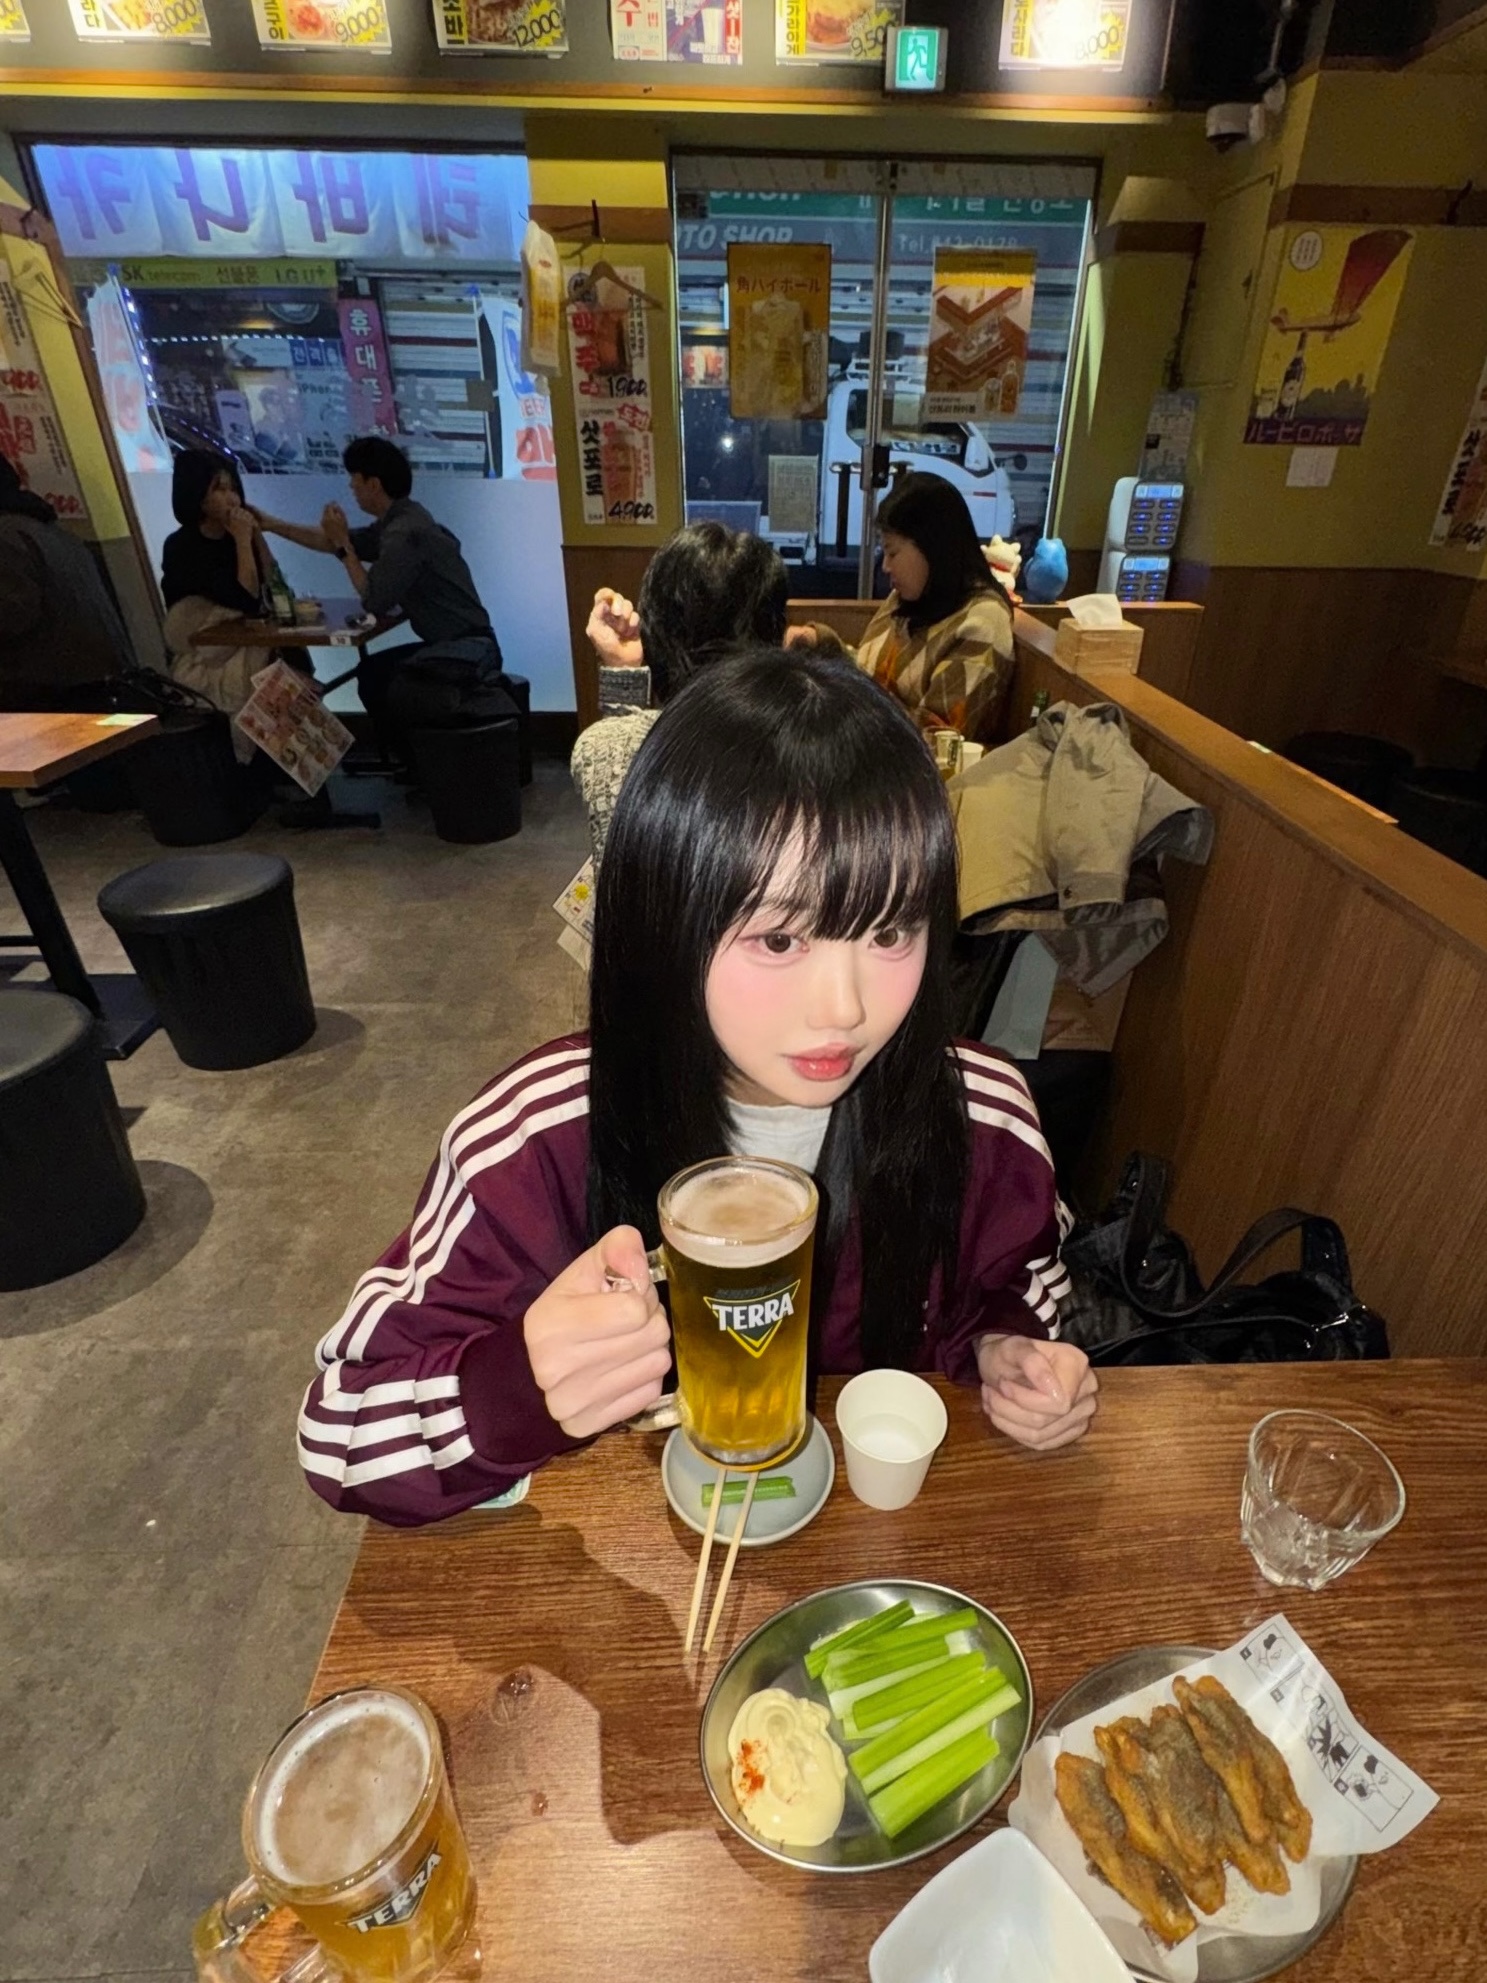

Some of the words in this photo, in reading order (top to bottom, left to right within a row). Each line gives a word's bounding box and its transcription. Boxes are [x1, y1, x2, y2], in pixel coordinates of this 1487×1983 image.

[152, 0, 198, 34] 8,000
[335, 6, 380, 43] 9,000
[512, 9, 561, 48] 12,000
[122, 264, 144, 281] SK
[712, 1292, 795, 1332] TERRA
[346, 1852, 442, 1934] TERRA
